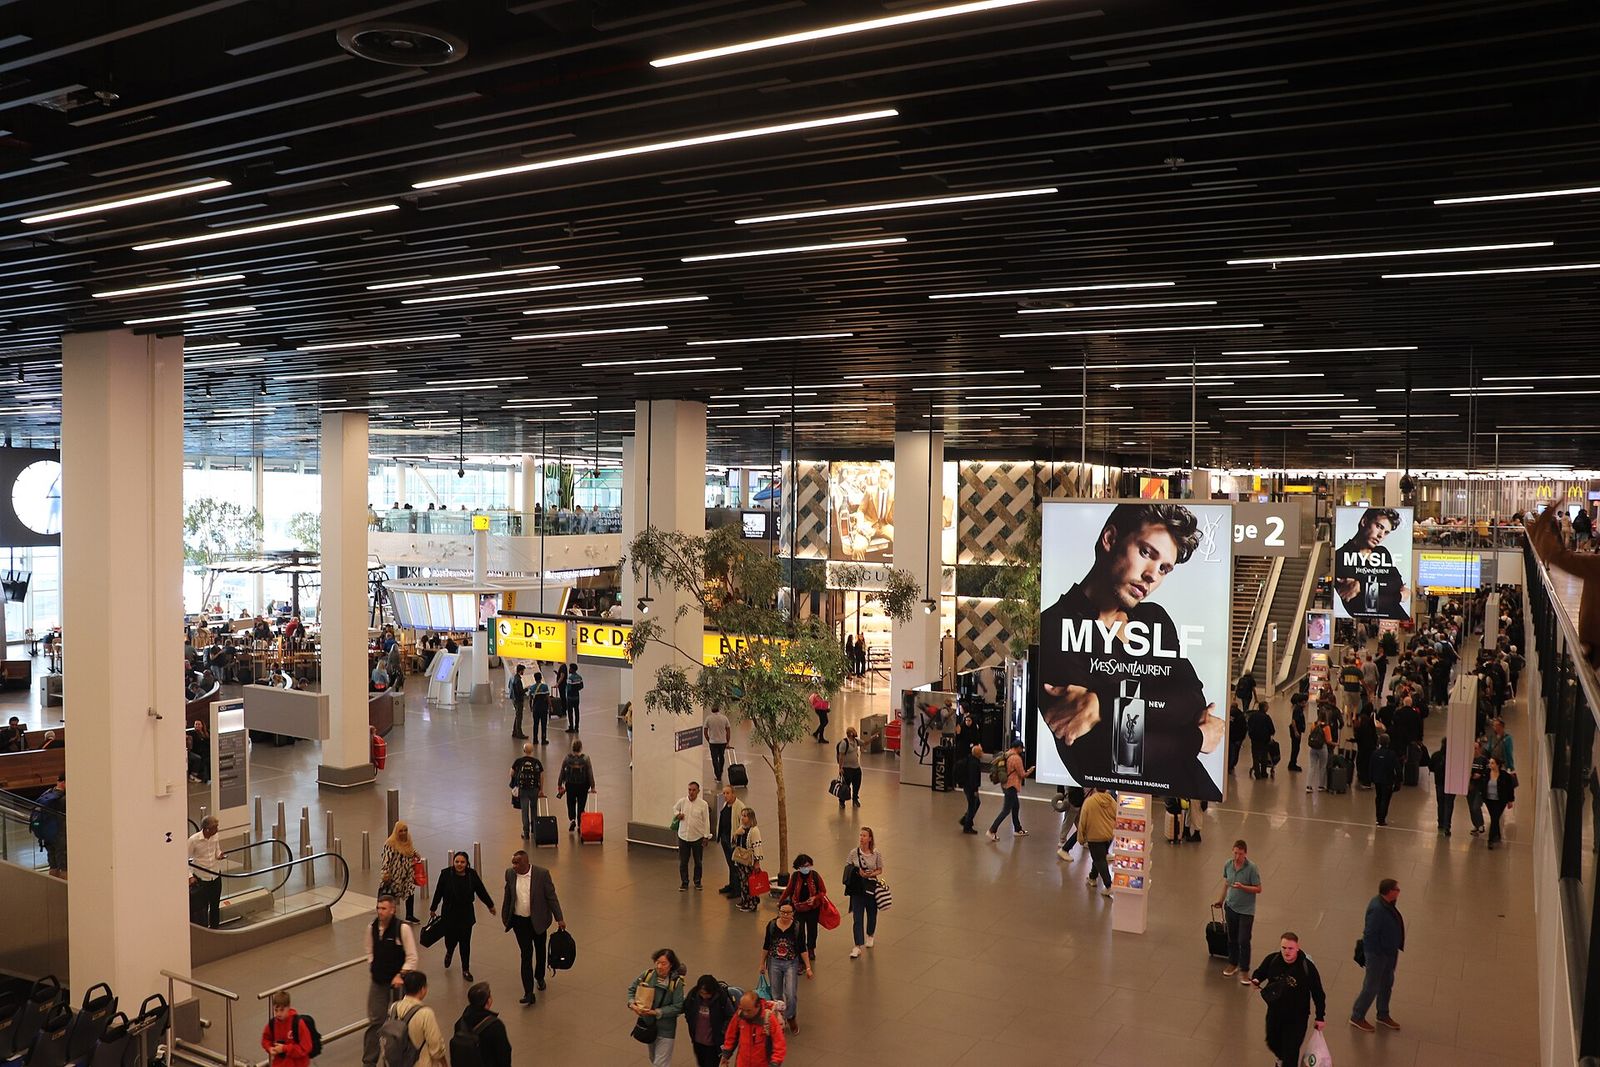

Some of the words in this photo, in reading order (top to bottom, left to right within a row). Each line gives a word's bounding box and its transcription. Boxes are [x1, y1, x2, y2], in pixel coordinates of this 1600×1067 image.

[1234, 524, 1258, 543] ge
[1264, 516, 1285, 546] 2
[524, 622, 534, 638] D
[538, 625, 556, 637] 1-57
[579, 627, 588, 643] B
[594, 628, 603, 644] C
[612, 630, 623, 646] D
[1061, 618, 1205, 659] MYSLF
[1148, 701, 1165, 709] NEW
[935, 751, 945, 790] MYSL
[1093, 776, 1119, 784] MASCULINE
[1119, 778, 1143, 786] REFILLABLE
[1143, 780, 1170, 789] FRAGRANCE
